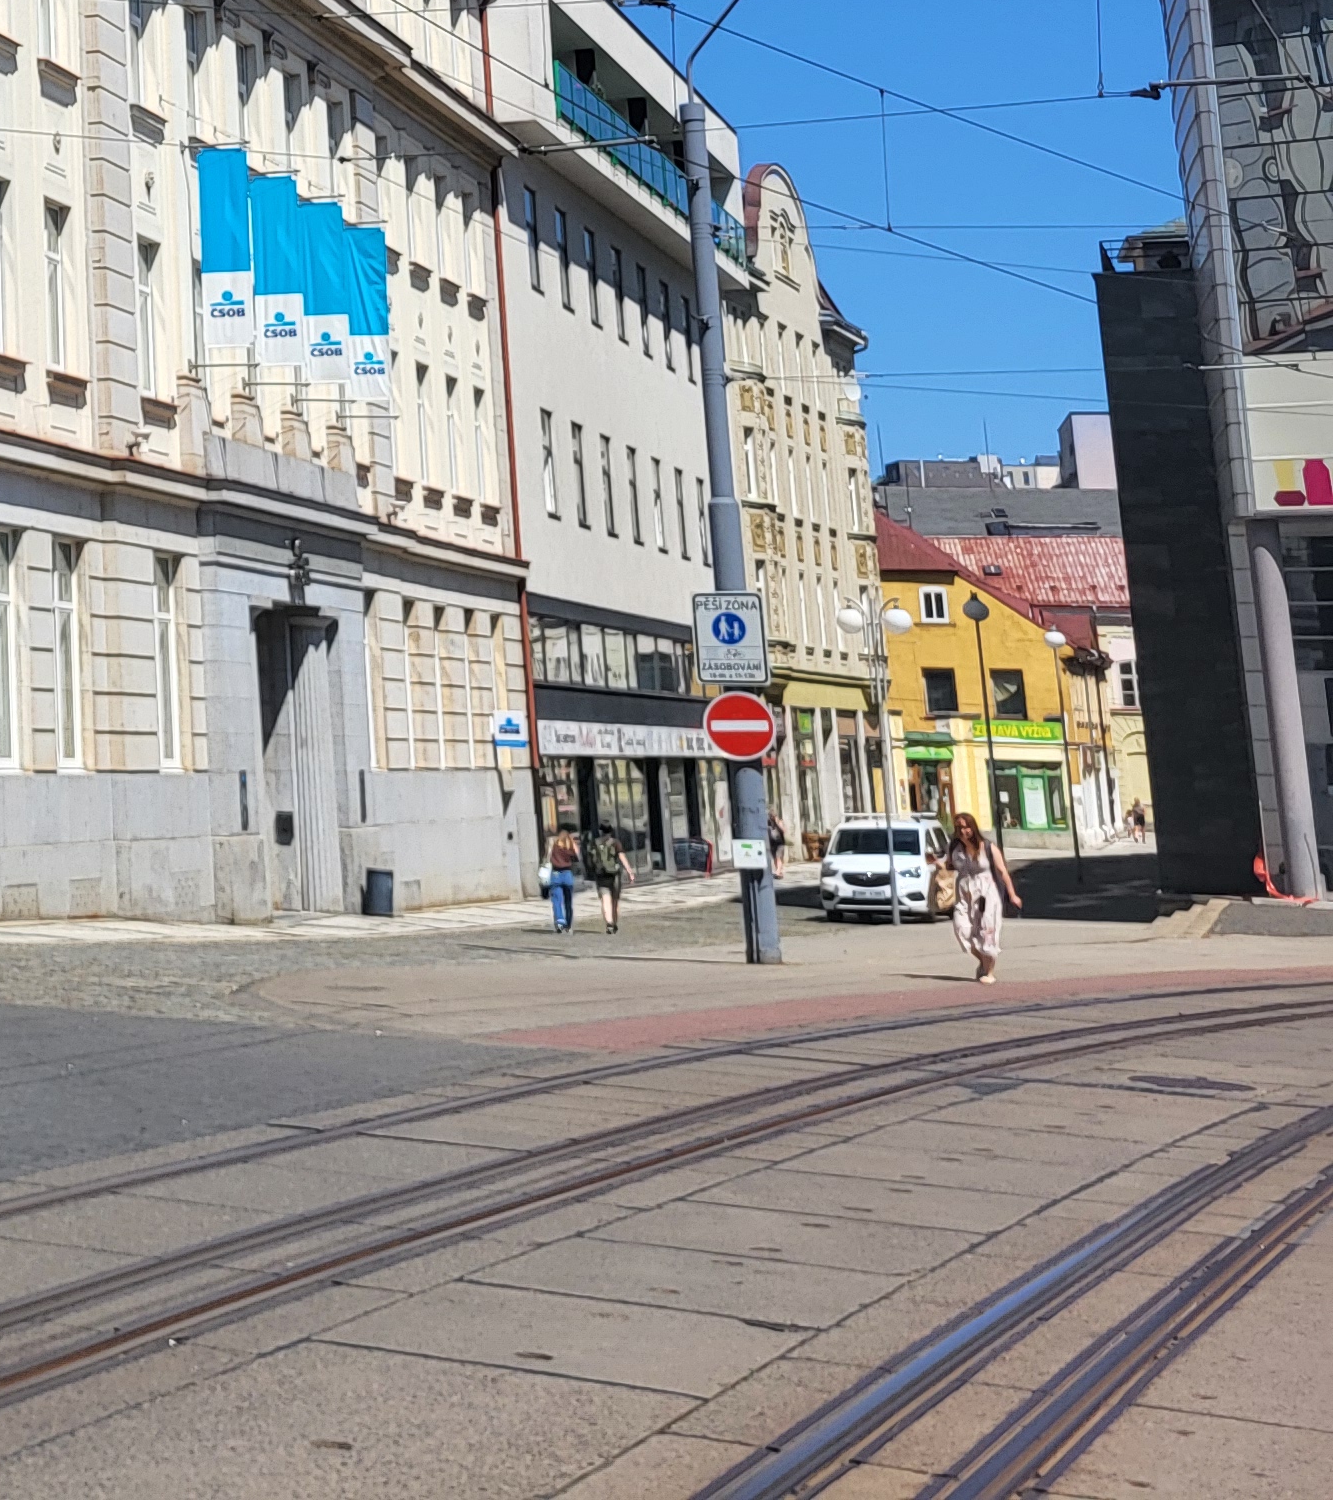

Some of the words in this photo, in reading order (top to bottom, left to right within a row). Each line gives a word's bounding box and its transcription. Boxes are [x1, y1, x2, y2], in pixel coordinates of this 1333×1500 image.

[210, 307, 245, 318] ČSOB
[696, 596, 723, 610] PĚŠÍ
[724, 597, 758, 610] ZÓNA
